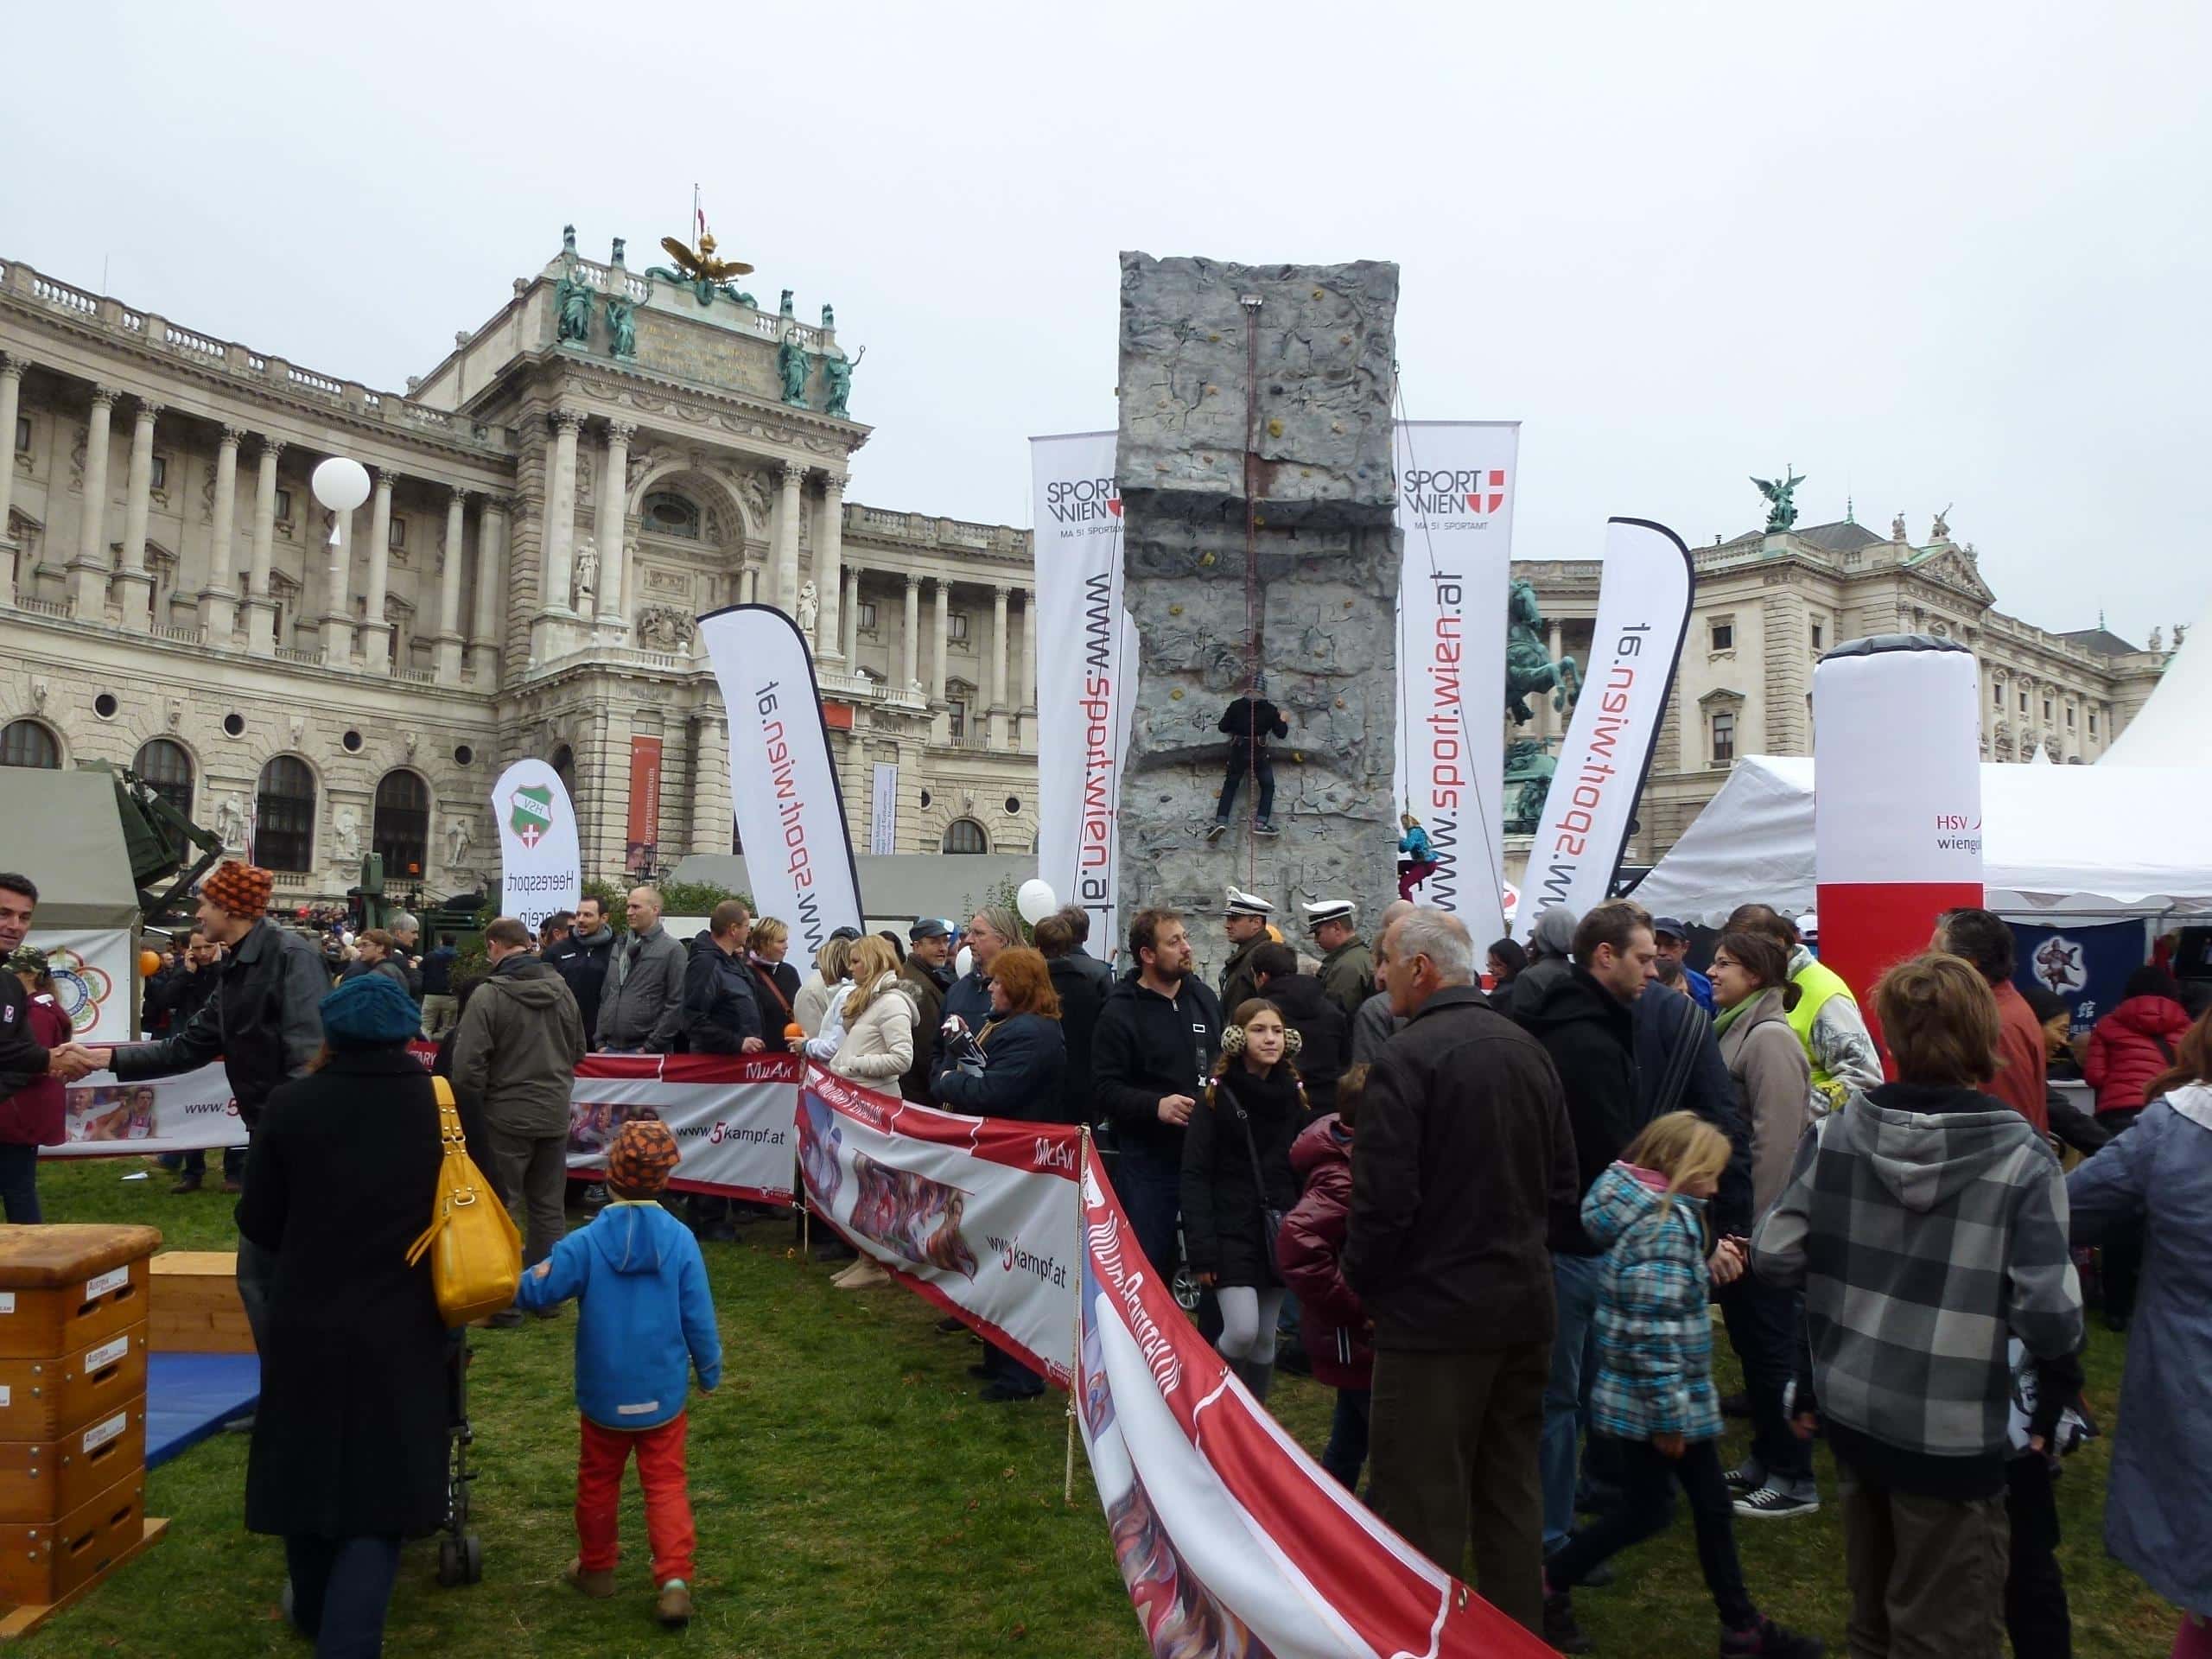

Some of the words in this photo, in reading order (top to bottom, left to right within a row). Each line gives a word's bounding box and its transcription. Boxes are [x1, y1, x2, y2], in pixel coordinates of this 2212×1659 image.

[1047, 478, 1116, 503] SPORT
[1403, 470, 1482, 493] SPORT
[1048, 500, 1107, 523] WIEN
[1404, 493, 1465, 514] WIEN
[1087, 524, 1126, 535] SPORTAM
[1444, 522, 1489, 531] SPORTAMT
[1079, 573, 1116, 913] www.sport.wien.at
[1427, 571, 1465, 912] www.sport.wien.at
[643, 767, 656, 846] Papyrusmuseum
[1936, 815, 1967, 830] HSV
[677, 1122, 785, 1146] www.5kampf.at
